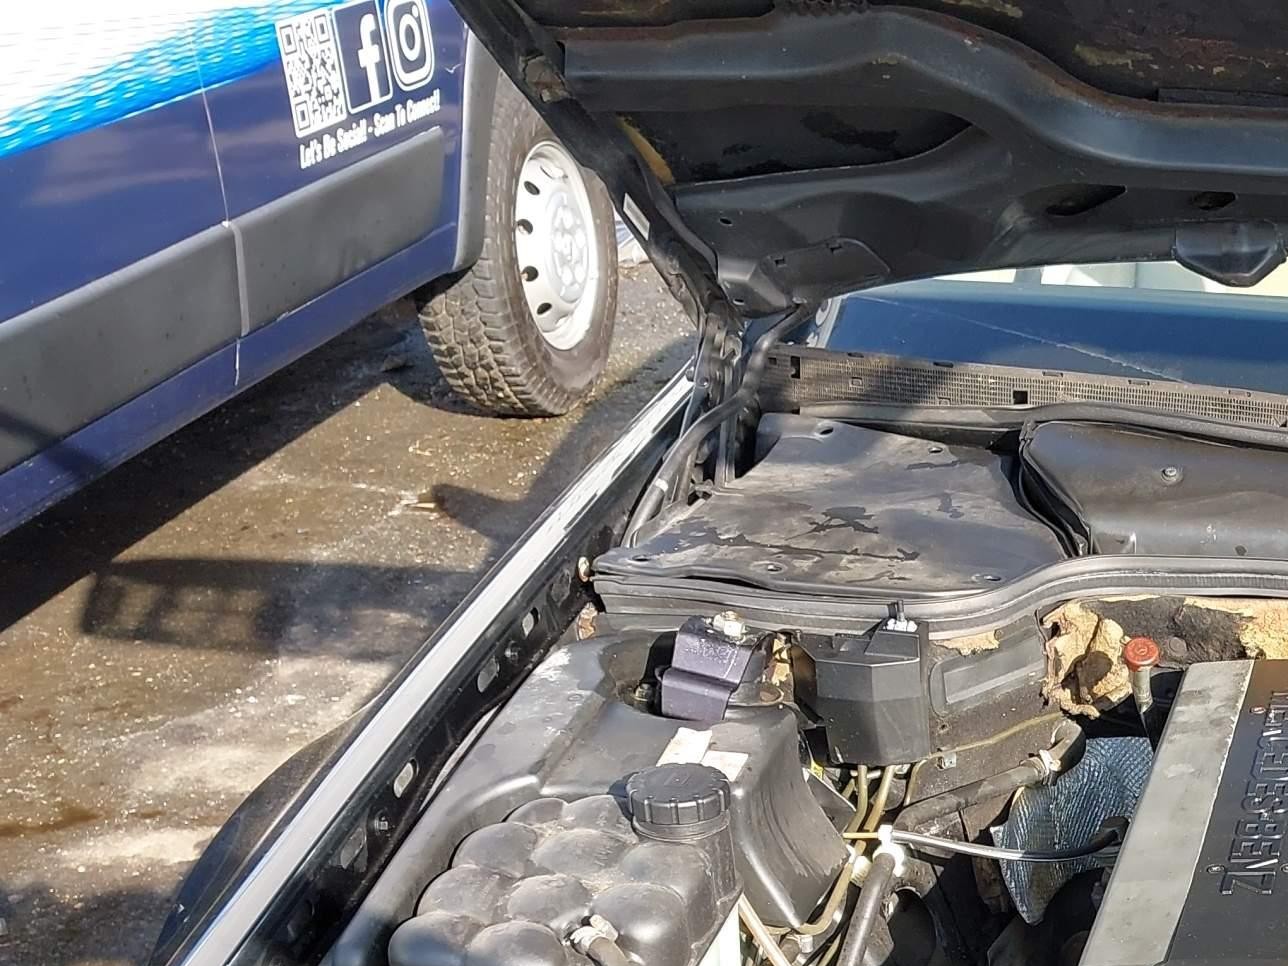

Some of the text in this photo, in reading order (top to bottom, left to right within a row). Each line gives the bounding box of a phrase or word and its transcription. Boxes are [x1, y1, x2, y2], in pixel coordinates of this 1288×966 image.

[300, 139, 322, 169] Let's
[322, 134, 336, 159] Be
[374, 112, 396, 137] Scan
[395, 103, 406, 127] To
